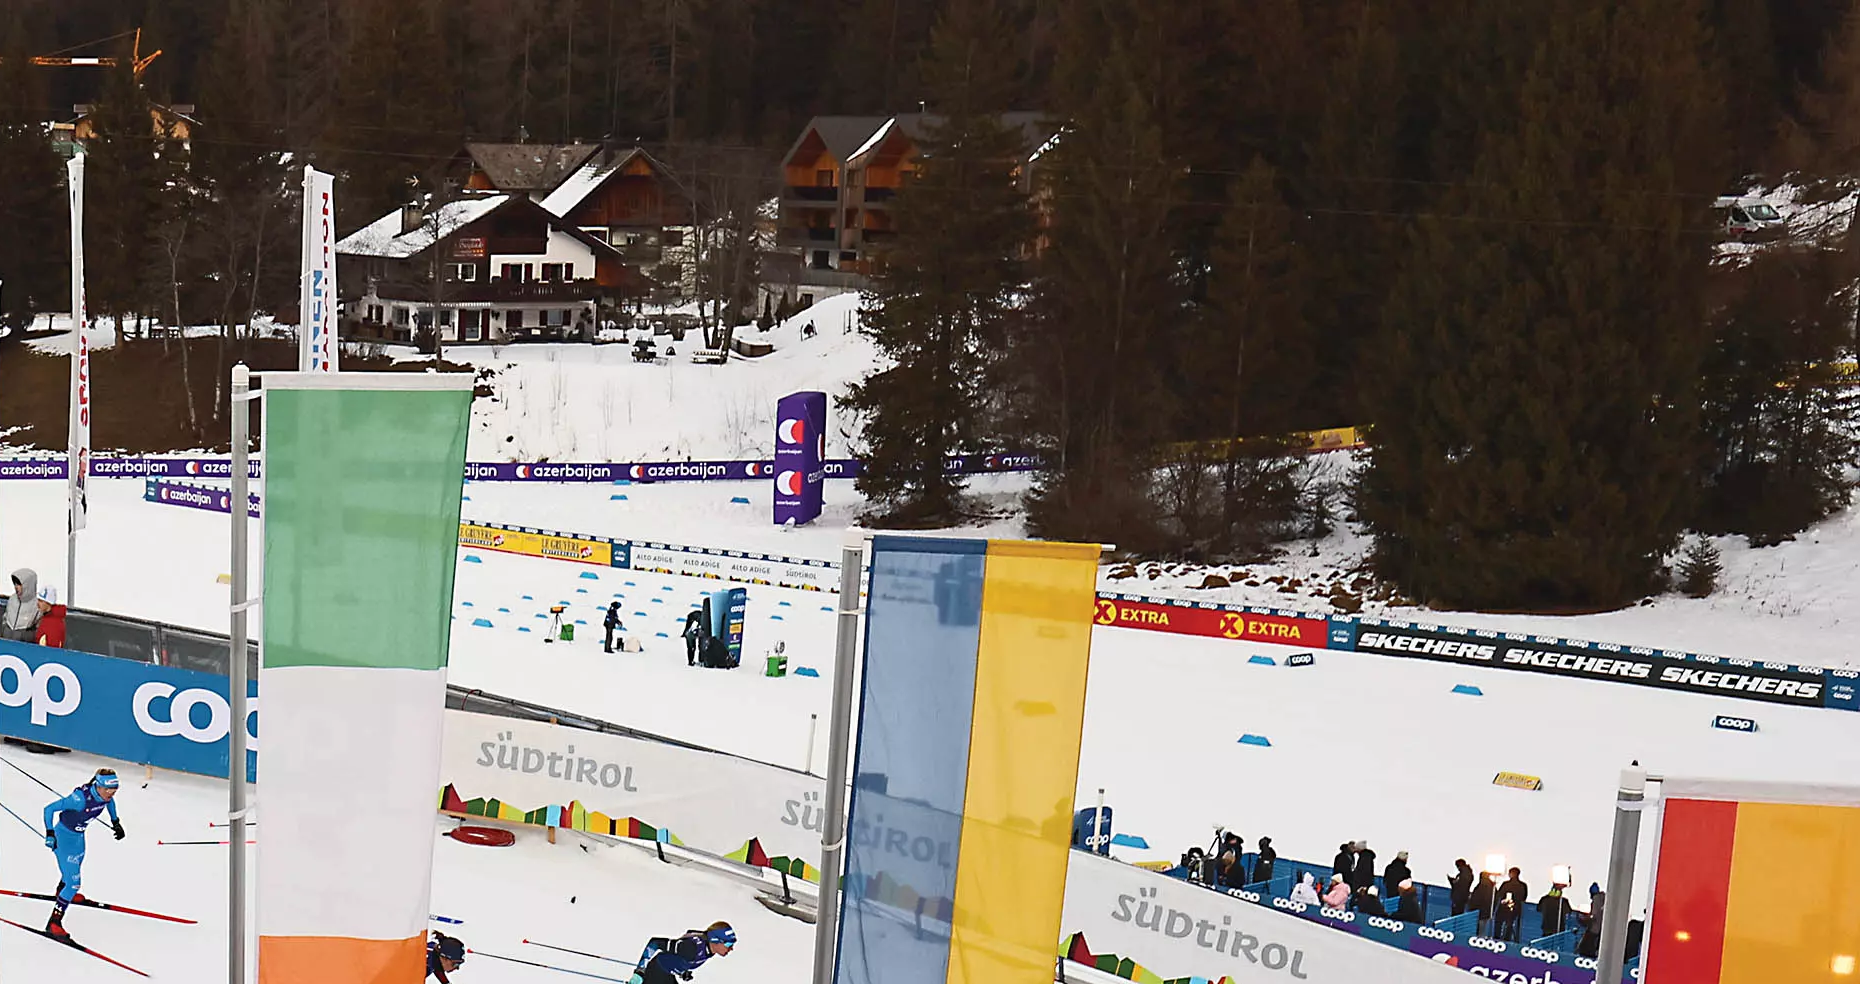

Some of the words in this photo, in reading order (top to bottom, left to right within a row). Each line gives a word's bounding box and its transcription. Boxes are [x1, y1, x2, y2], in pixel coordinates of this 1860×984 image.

[1, 463, 63, 479] azerbaijan
[94, 459, 168, 477] azerbaijan
[534, 463, 611, 481] azerbaijan
[648, 462, 726, 480] azerbaijan
[170, 488, 212, 506] azerbaijan
[1120, 608, 1170, 626] EXTRA
[1248, 621, 1301, 640] EXTRA
[1292, 655, 1312, 664] coop
[1359, 632, 1496, 661] SKECHERS
[1503, 649, 1652, 680] SKECHERS
[1660, 666, 1822, 699] SKECHERS
[1718, 717, 1751, 729] coop
[1273, 896, 1307, 914] coop
[1320, 906, 1356, 923] coop
[1367, 915, 1404, 933] coop
[1418, 925, 1455, 943] coop
[1468, 935, 1507, 954] coop
[1520, 946, 1559, 964] coop
